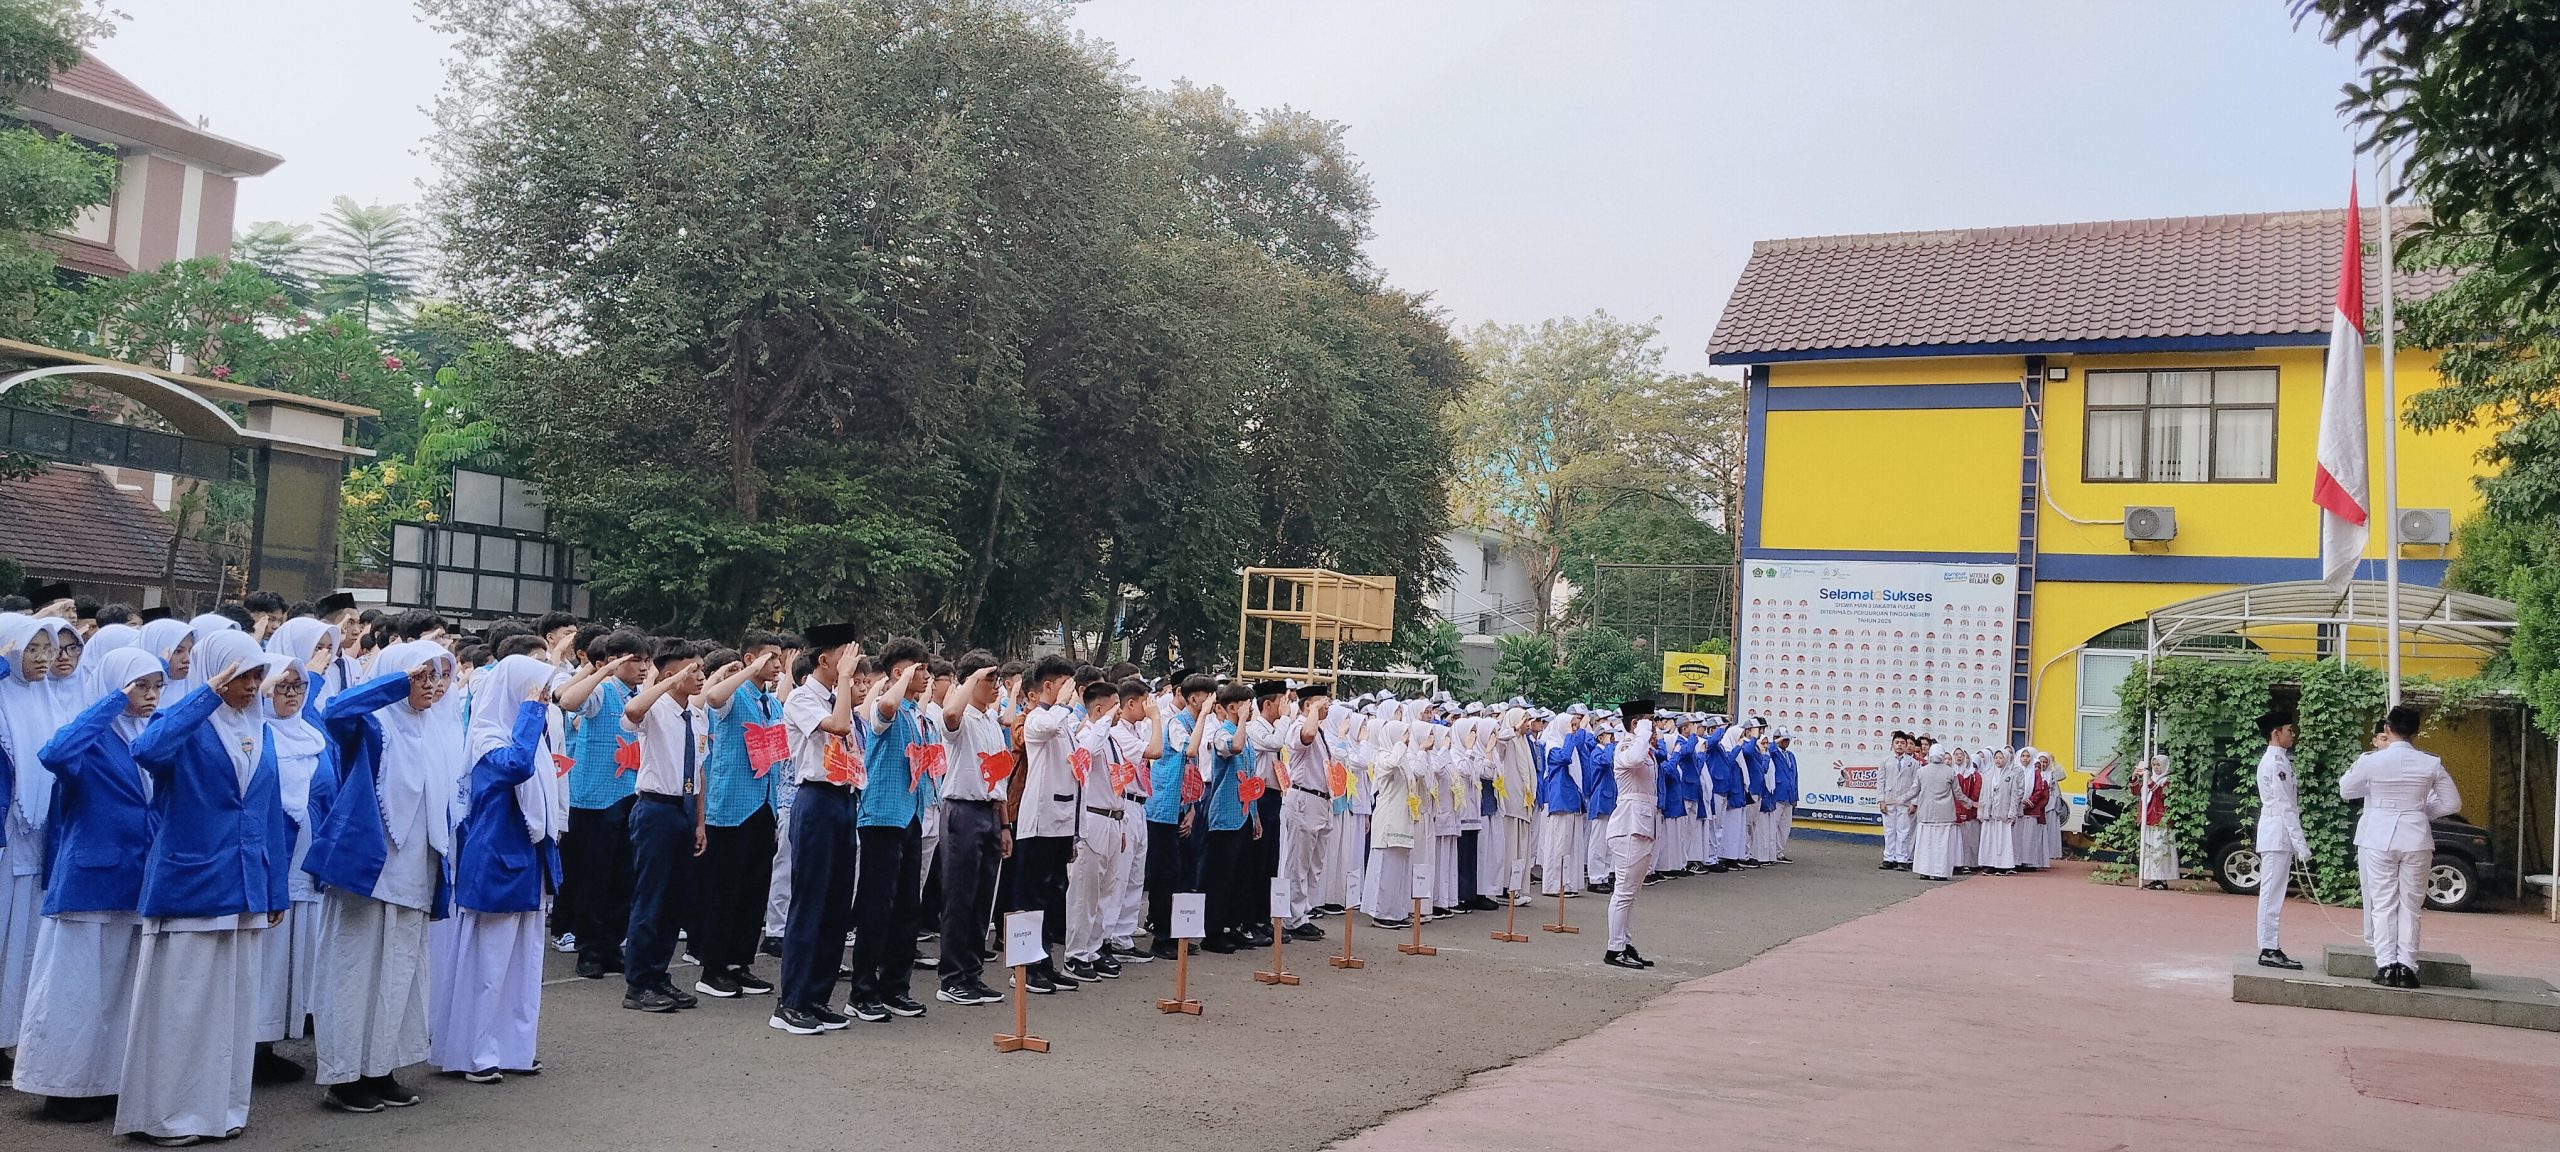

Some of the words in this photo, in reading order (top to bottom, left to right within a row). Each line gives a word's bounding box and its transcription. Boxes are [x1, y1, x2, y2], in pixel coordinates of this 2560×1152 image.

[1820, 588, 1874, 600] Selamat
[1882, 590, 1932, 602] Sukses
[1818, 794, 1854, 804] SNPMB
